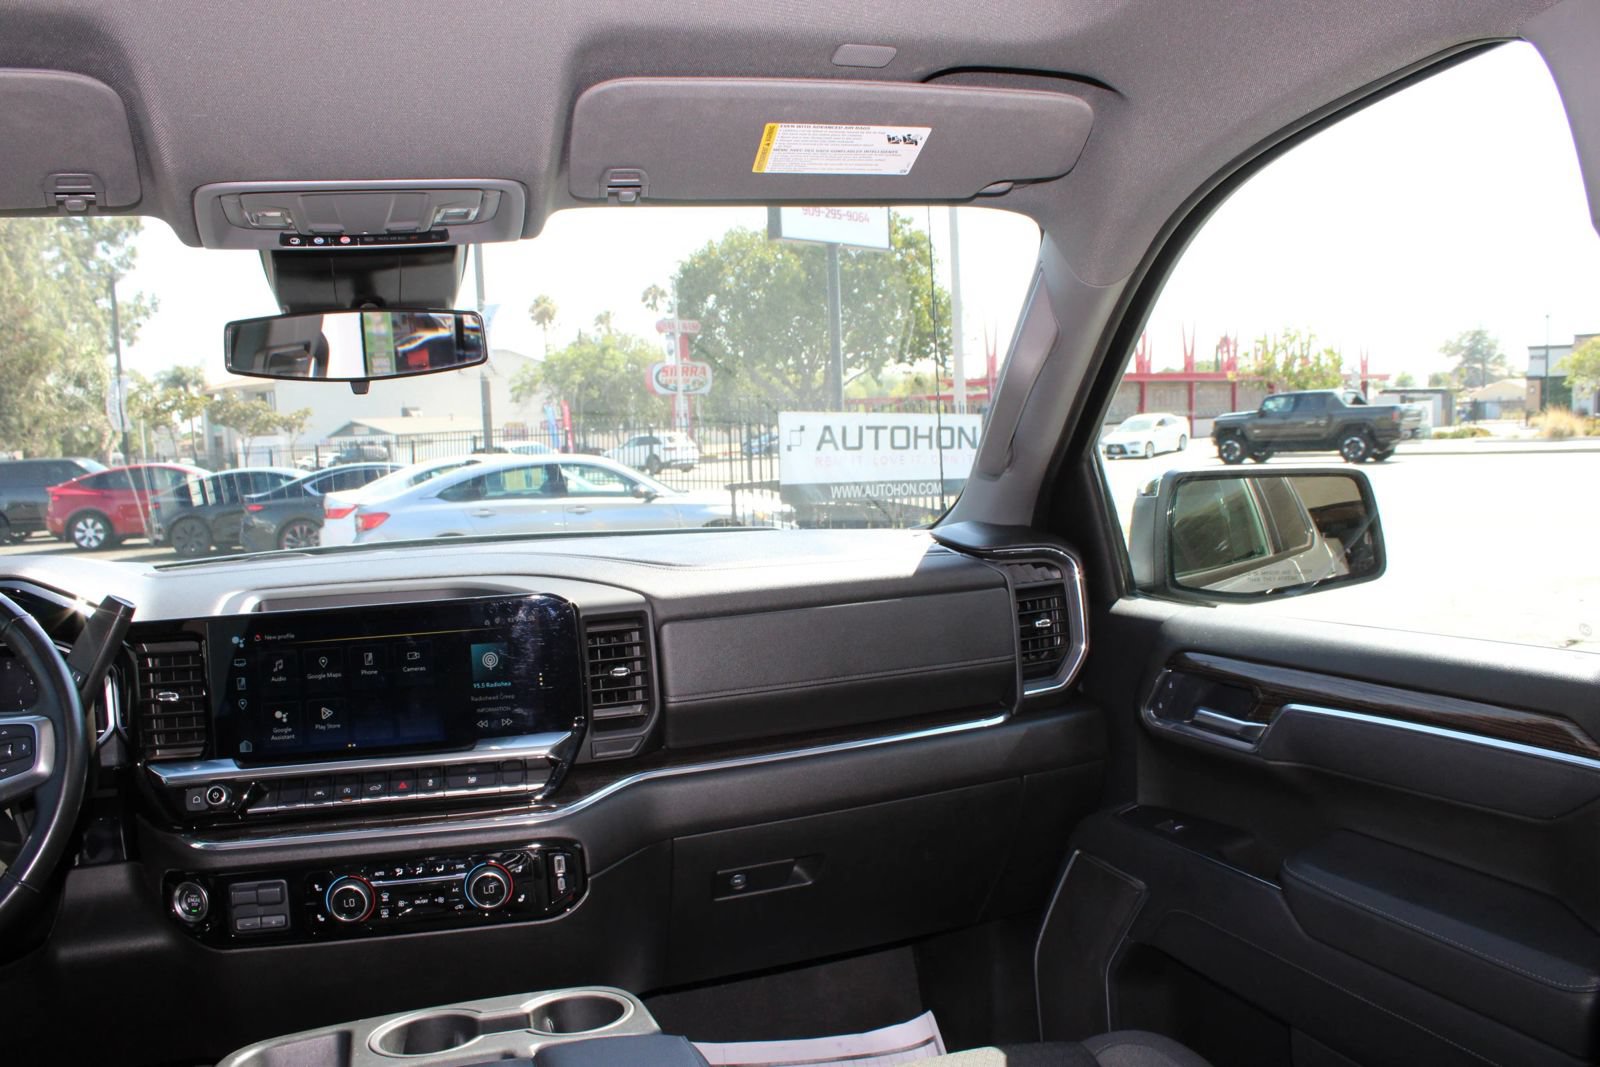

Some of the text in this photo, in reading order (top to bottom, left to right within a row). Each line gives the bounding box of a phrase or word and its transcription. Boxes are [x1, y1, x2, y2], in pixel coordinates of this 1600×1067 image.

[662, 365, 707, 377] SIRRA
[816, 425, 978, 451] AUTOHON
[831, 482, 942, 499] WWW.AUTOHON.COM
[278, 633, 295, 641] profile
[273, 726, 292, 734] Google
[271, 733, 295, 741] Assistant
